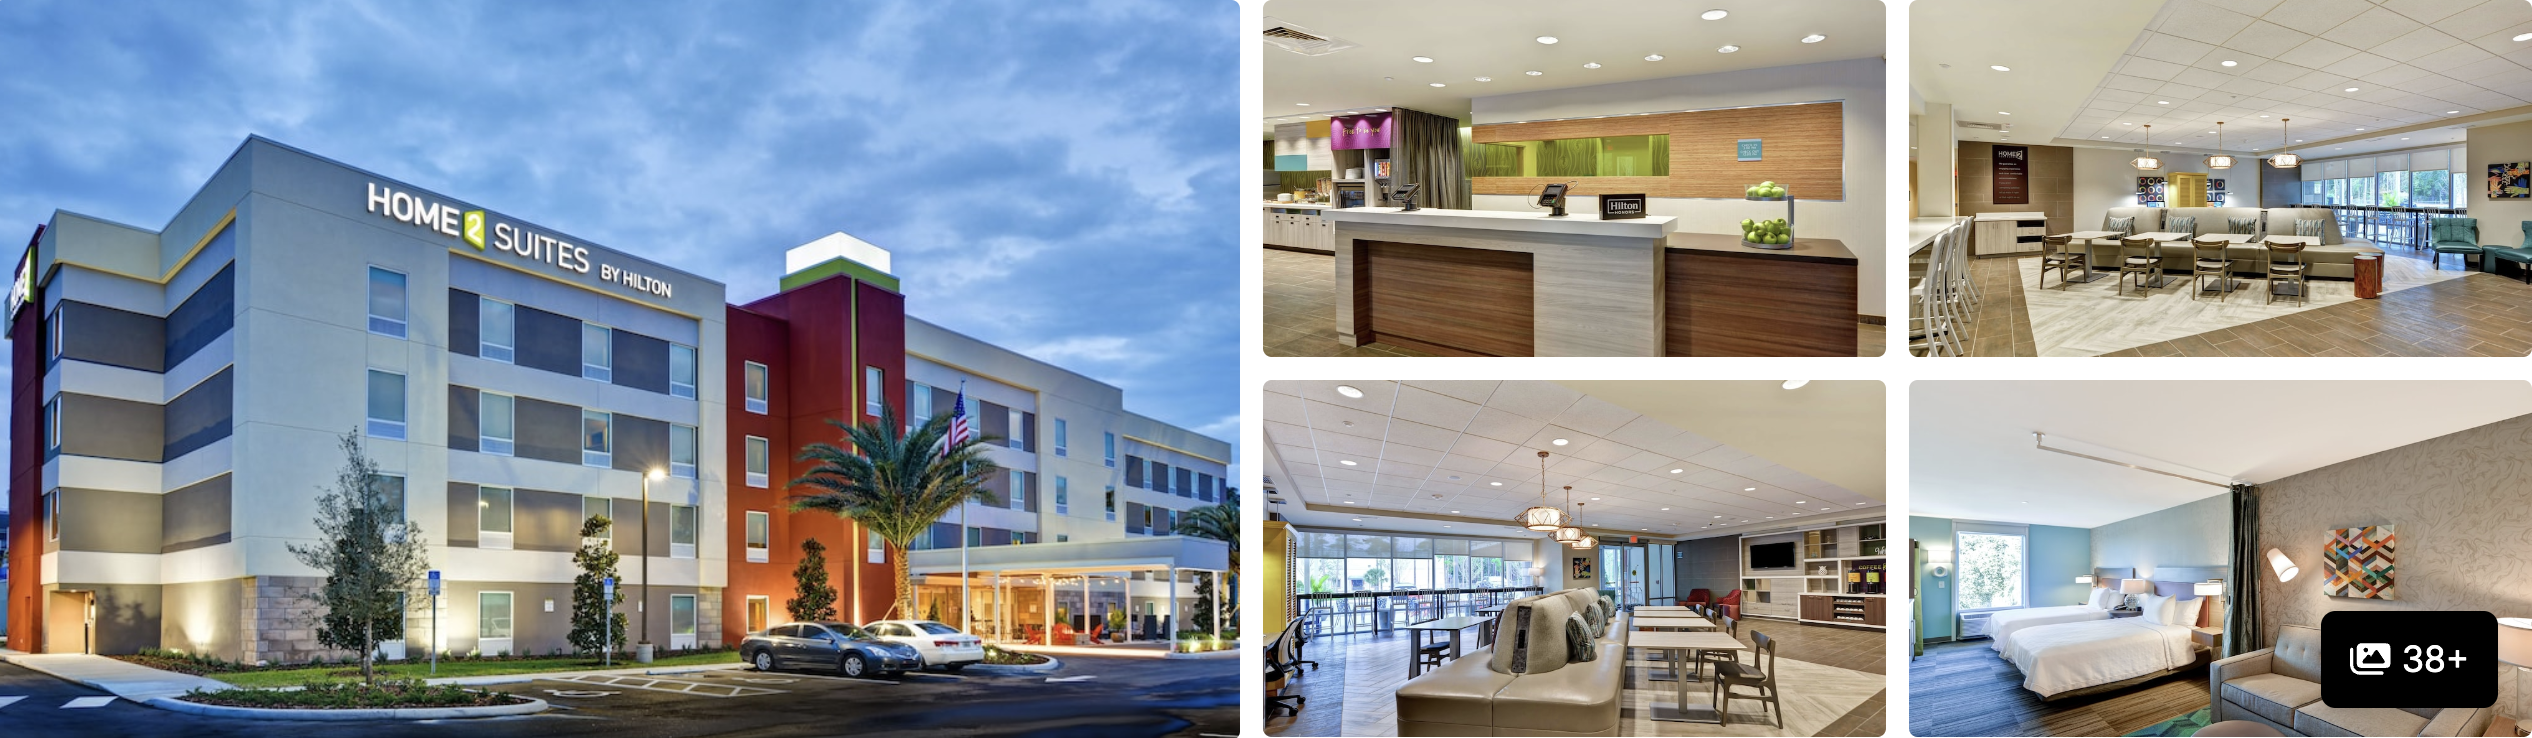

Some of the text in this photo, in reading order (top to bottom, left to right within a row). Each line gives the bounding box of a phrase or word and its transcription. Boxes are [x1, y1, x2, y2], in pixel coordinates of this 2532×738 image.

[1610, 202, 1638, 210] Hilton
[368, 182, 460, 236] HOME
[494, 222, 590, 273] SUITES
[601, 263, 621, 281] BY
[623, 269, 672, 298] HILTON
